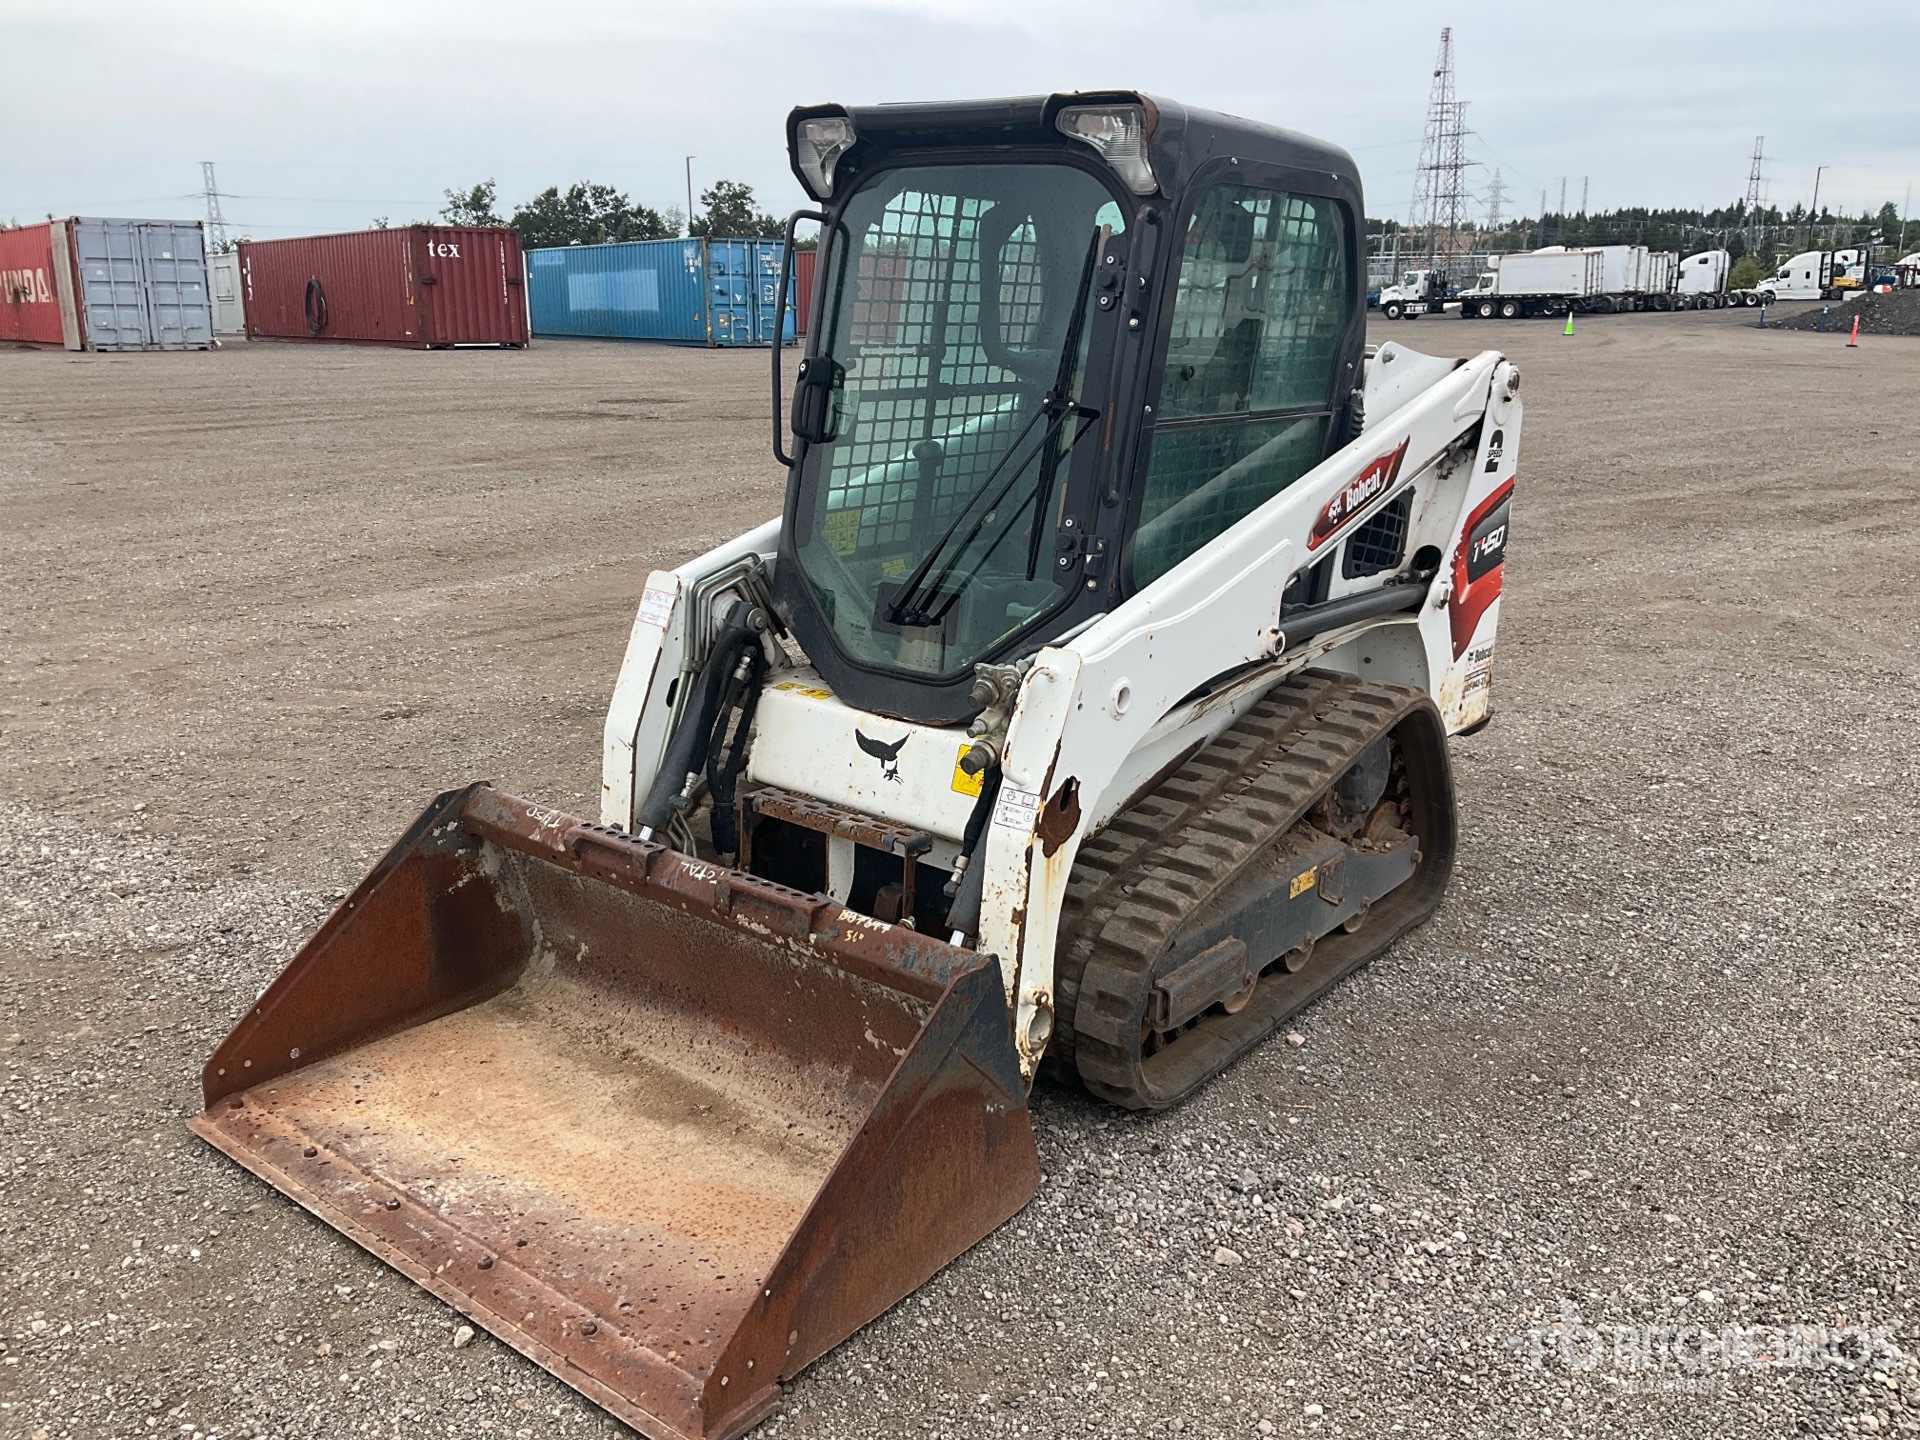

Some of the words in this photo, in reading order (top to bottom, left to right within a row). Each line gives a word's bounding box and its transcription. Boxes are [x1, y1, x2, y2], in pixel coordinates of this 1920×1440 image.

[427, 239, 462, 258] tex
[1346, 467, 1381, 512] Bobcat
[1473, 525, 1505, 563] T450
